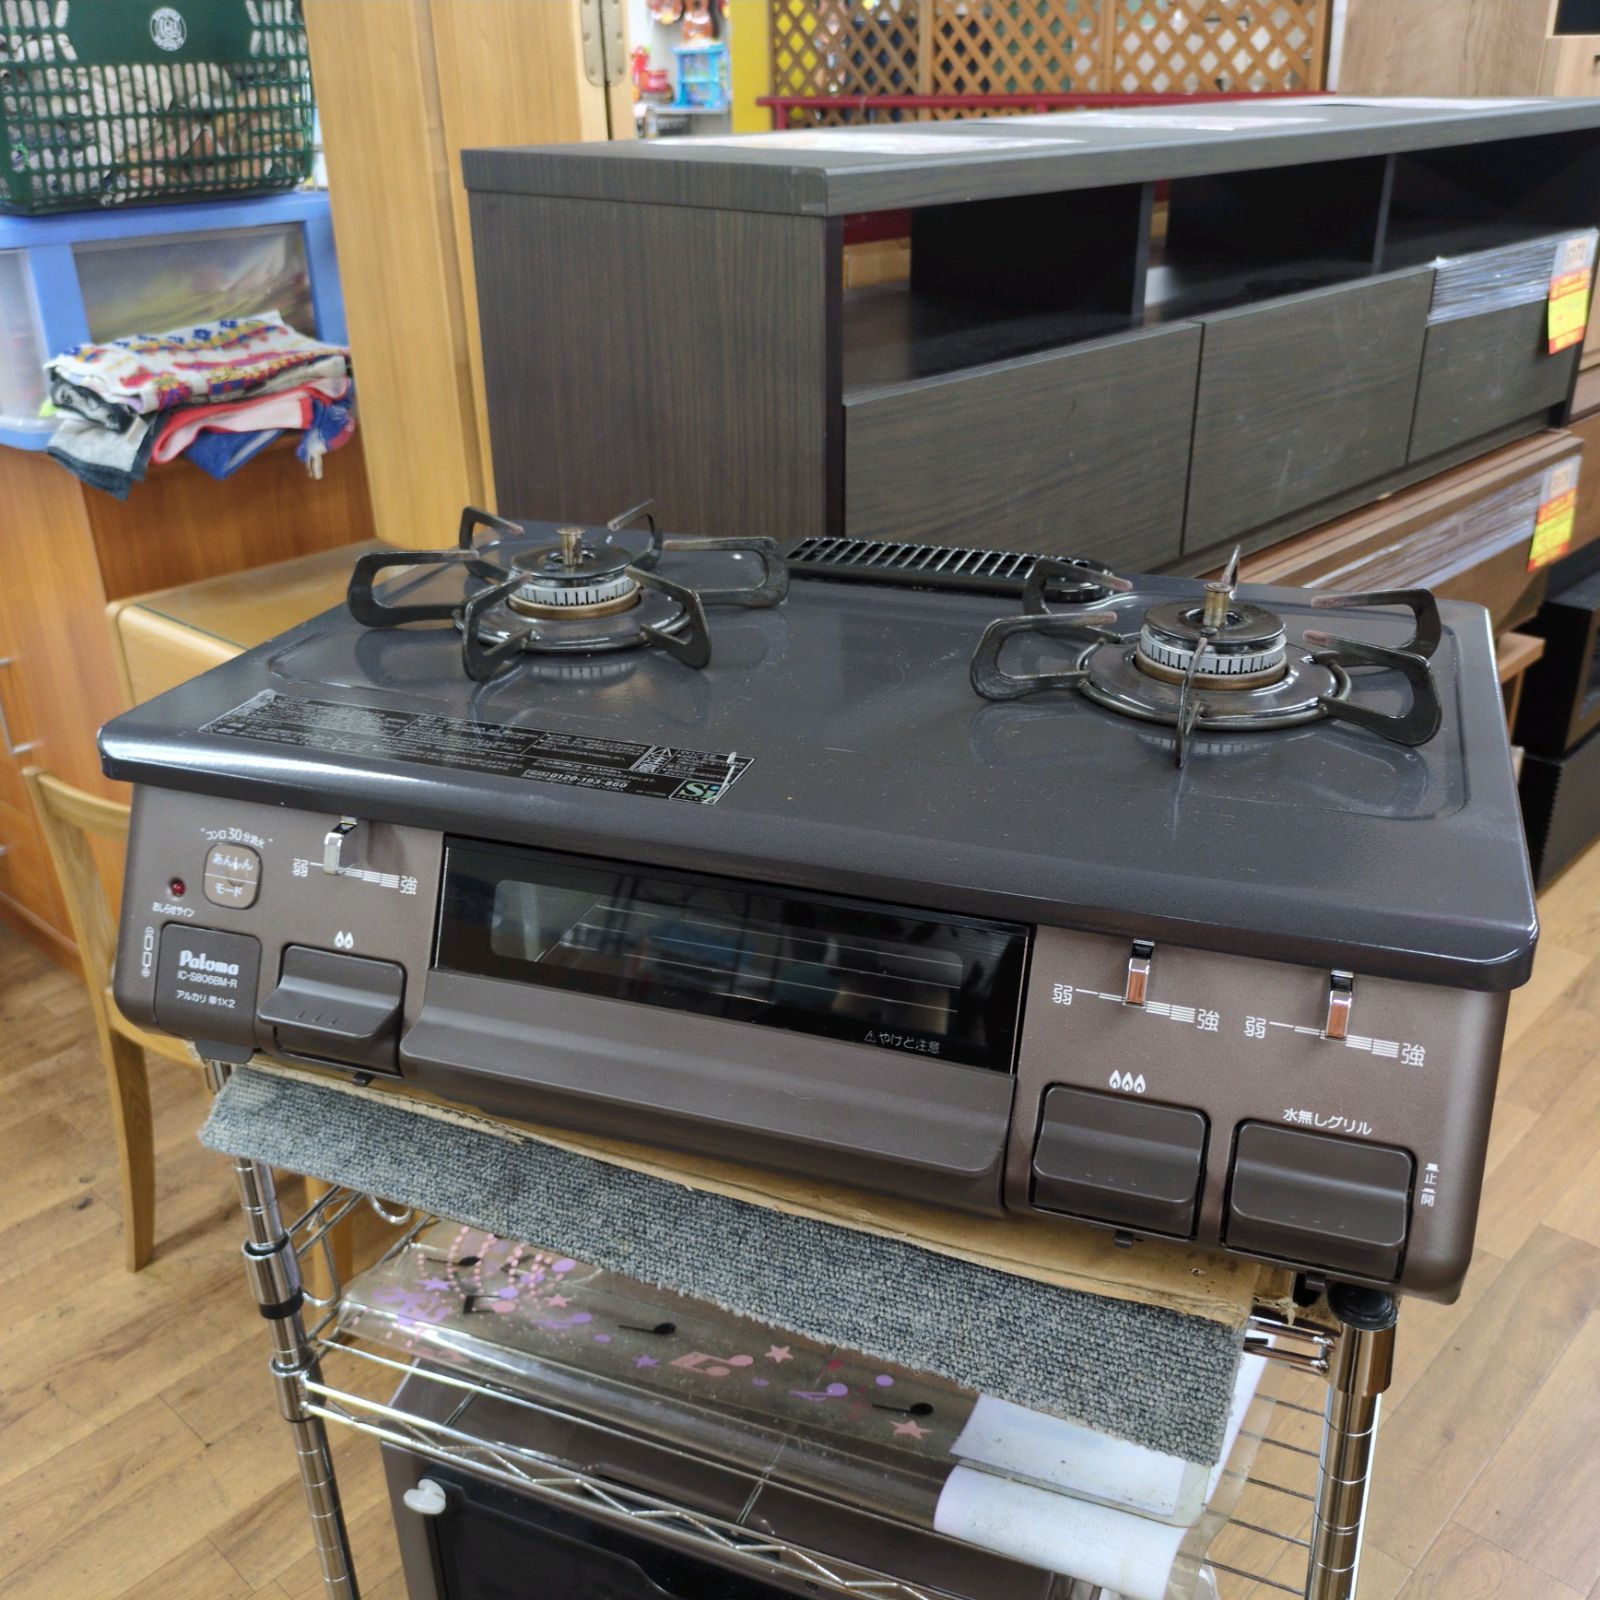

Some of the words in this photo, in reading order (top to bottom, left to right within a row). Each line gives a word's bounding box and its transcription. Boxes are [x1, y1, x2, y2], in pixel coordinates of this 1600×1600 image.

[212, 852, 253, 871] あんしん
[291, 858, 309, 877] 弱
[215, 882, 243, 897] モード
[400, 875, 418, 896] 強
[152, 901, 195, 918] おしらせサイン
[179, 949, 240, 976] Paloma
[176, 989, 207, 1004] アルカリ
[1051, 983, 1074, 1006] 弱
[1197, 1008, 1220, 1032] 強
[1244, 1015, 1266, 1039] 弱
[878, 1031, 940, 1055] やけど注意
[1401, 1042, 1426, 1067] 強
[1282, 1107, 1373, 1136] 水無しグリル
[1424, 1172, 1437, 1185] 止
